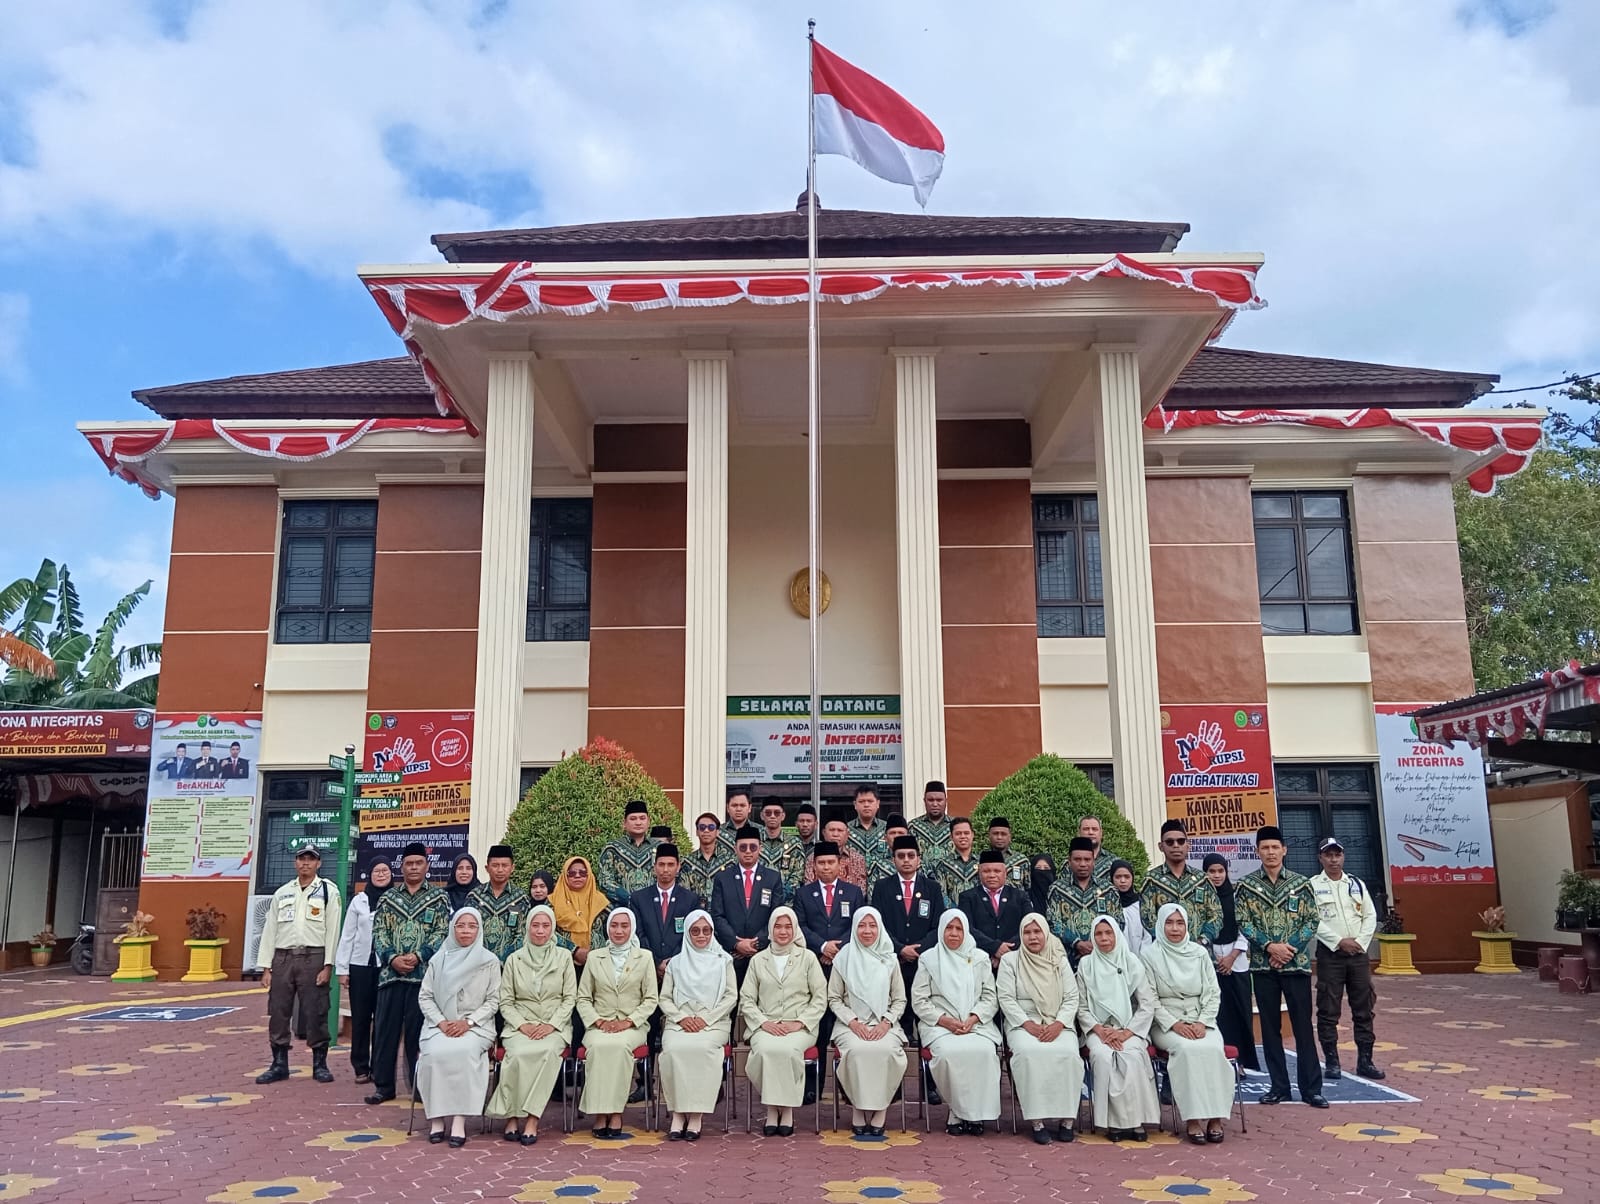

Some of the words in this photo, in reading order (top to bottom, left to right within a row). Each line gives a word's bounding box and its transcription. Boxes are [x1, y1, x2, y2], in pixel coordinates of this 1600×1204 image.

[740, 700, 811, 712] SELAMAT
[823, 699, 886, 711] DATANG
[0, 716, 27, 728] ONA
[30, 715, 104, 728] INTEGRITAS
[787, 723, 810, 731] ANDA
[820, 723, 857, 731] EMASUKI
[860, 722, 901, 731] KAWASAN
[781, 734, 816, 747] ZON
[17, 746, 56, 755] KHUSUS
[58, 745, 104, 754] PEGAWAI
[1412, 746, 1445, 755] ZONA
[402, 762, 429, 773] RUPSI
[1397, 757, 1465, 767] INTEGRITAS
[176, 781, 226, 790] BerAKHLAK
[408, 787, 462, 803] INTEGRITAS
[1186, 797, 1243, 817] KAWASAN
[1183, 817, 1197, 833] NA
[1199, 811, 1266, 832] INTEGRITAS
